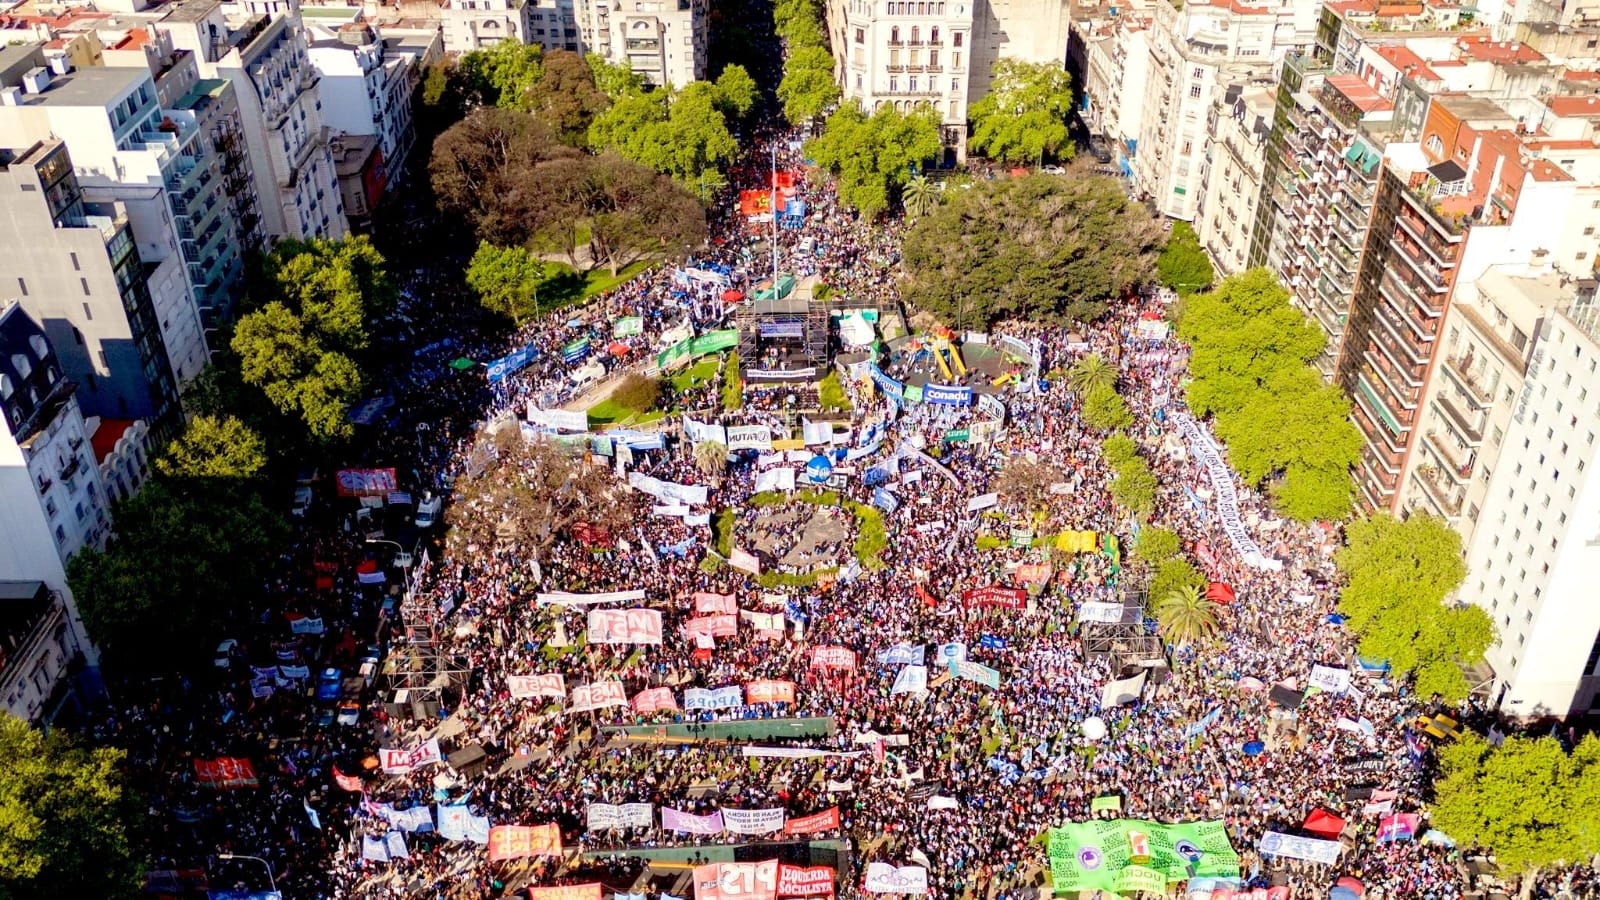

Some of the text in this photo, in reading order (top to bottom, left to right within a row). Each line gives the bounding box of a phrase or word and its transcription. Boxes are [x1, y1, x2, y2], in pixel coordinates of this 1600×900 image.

[928, 389, 970, 402] conadu
[780, 866, 829, 883] IZQUIERDA
[778, 881, 832, 896] SOCIALISTA
